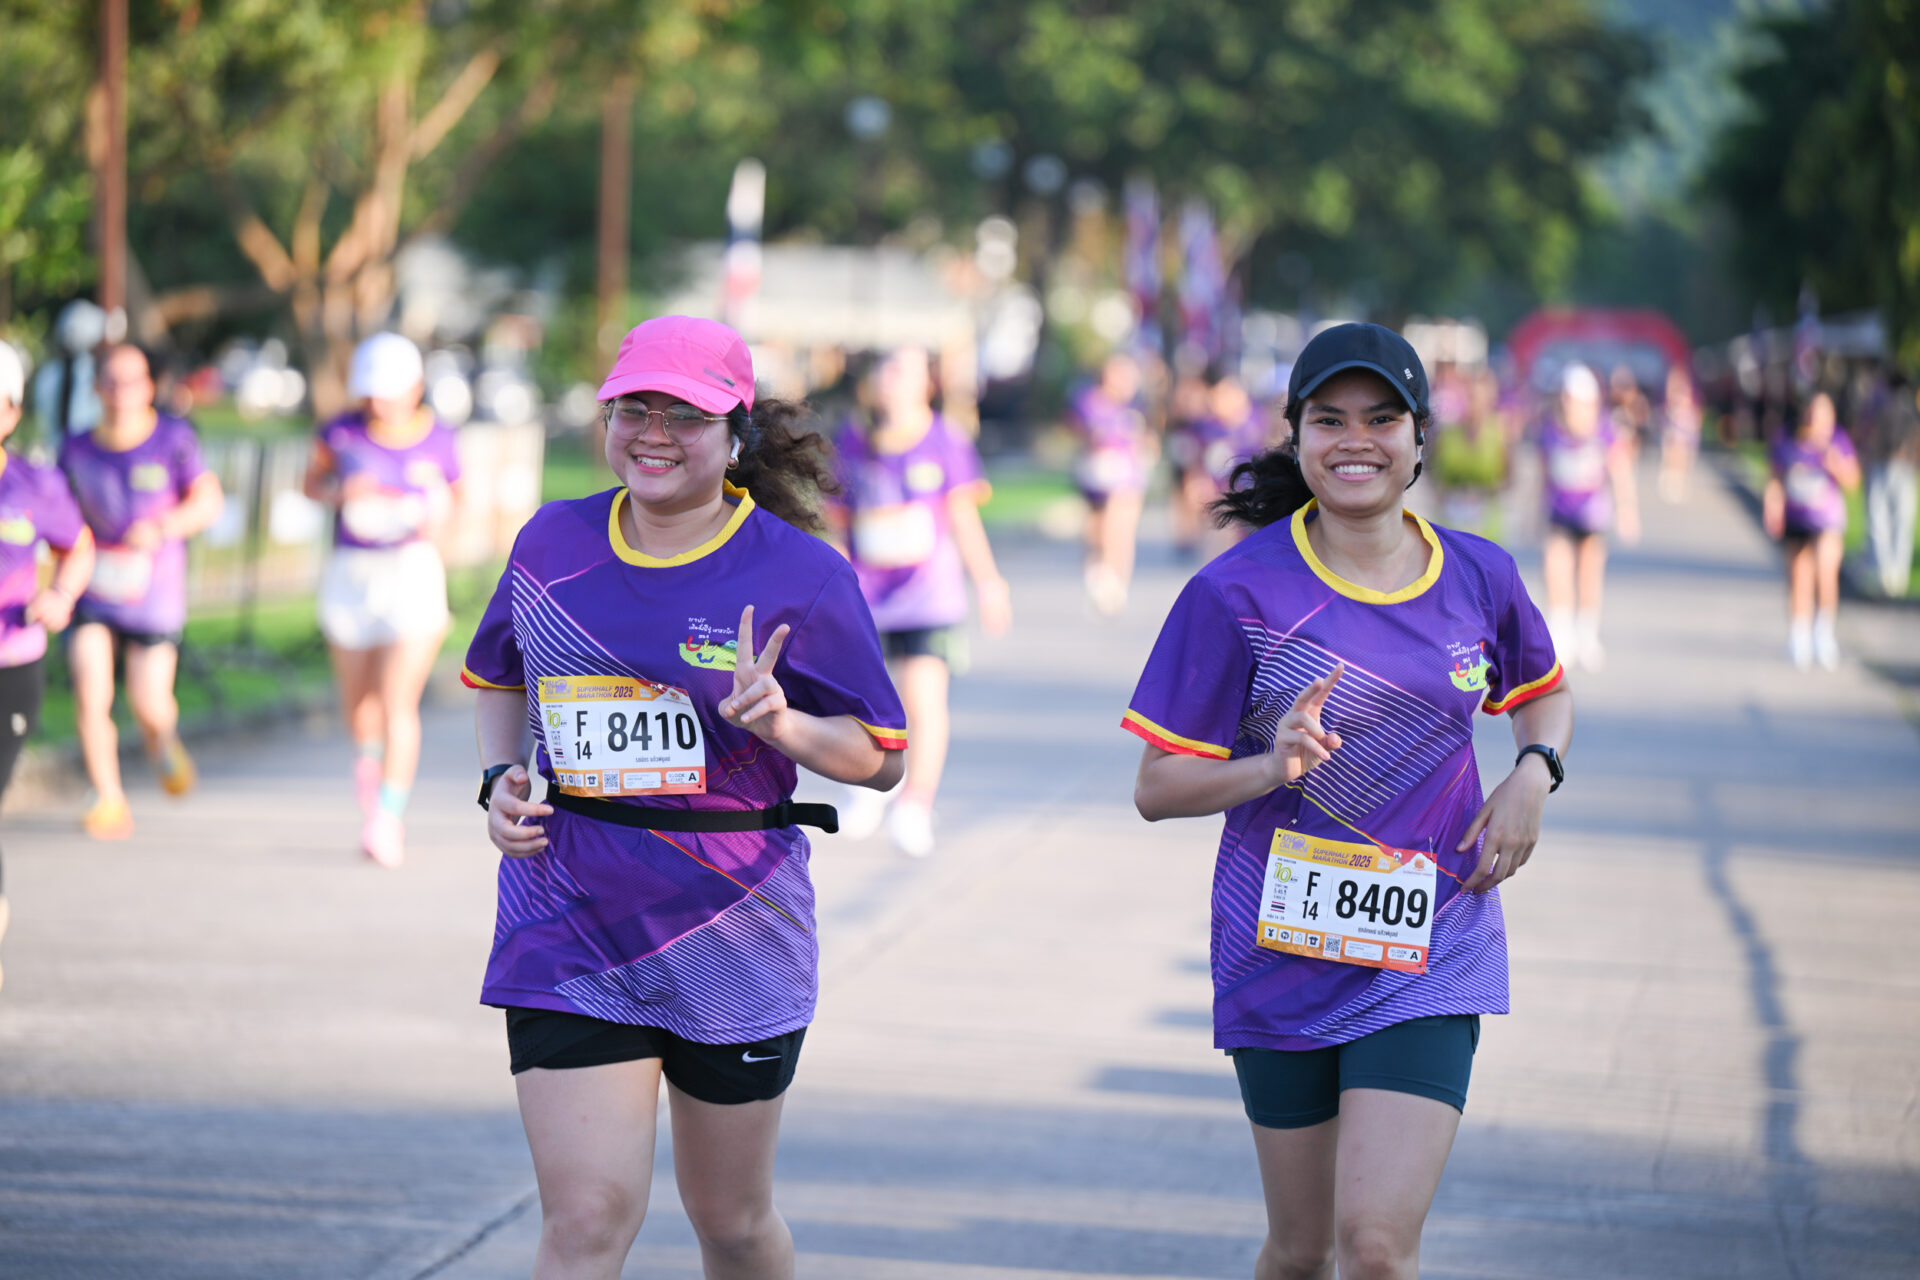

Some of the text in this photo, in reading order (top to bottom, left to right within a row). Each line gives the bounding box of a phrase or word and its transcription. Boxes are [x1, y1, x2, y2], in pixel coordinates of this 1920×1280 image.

[613, 686, 634, 698] 2025
[546, 709, 561, 728] 10
[576, 710, 588, 737] F
[607, 711, 697, 752] 8410
[575, 740, 592, 760] 14
[688, 772, 697, 781] A
[1312, 847, 1350, 858] SUPERHALF
[1312, 854, 1348, 865] MARATHON
[1349, 854, 1373, 868] 2025
[1274, 862, 1292, 883] 10
[1306, 871, 1321, 897] F
[1302, 900, 1319, 921] 14
[1335, 879, 1428, 929] 8409
[1410, 951, 1419, 961] A
